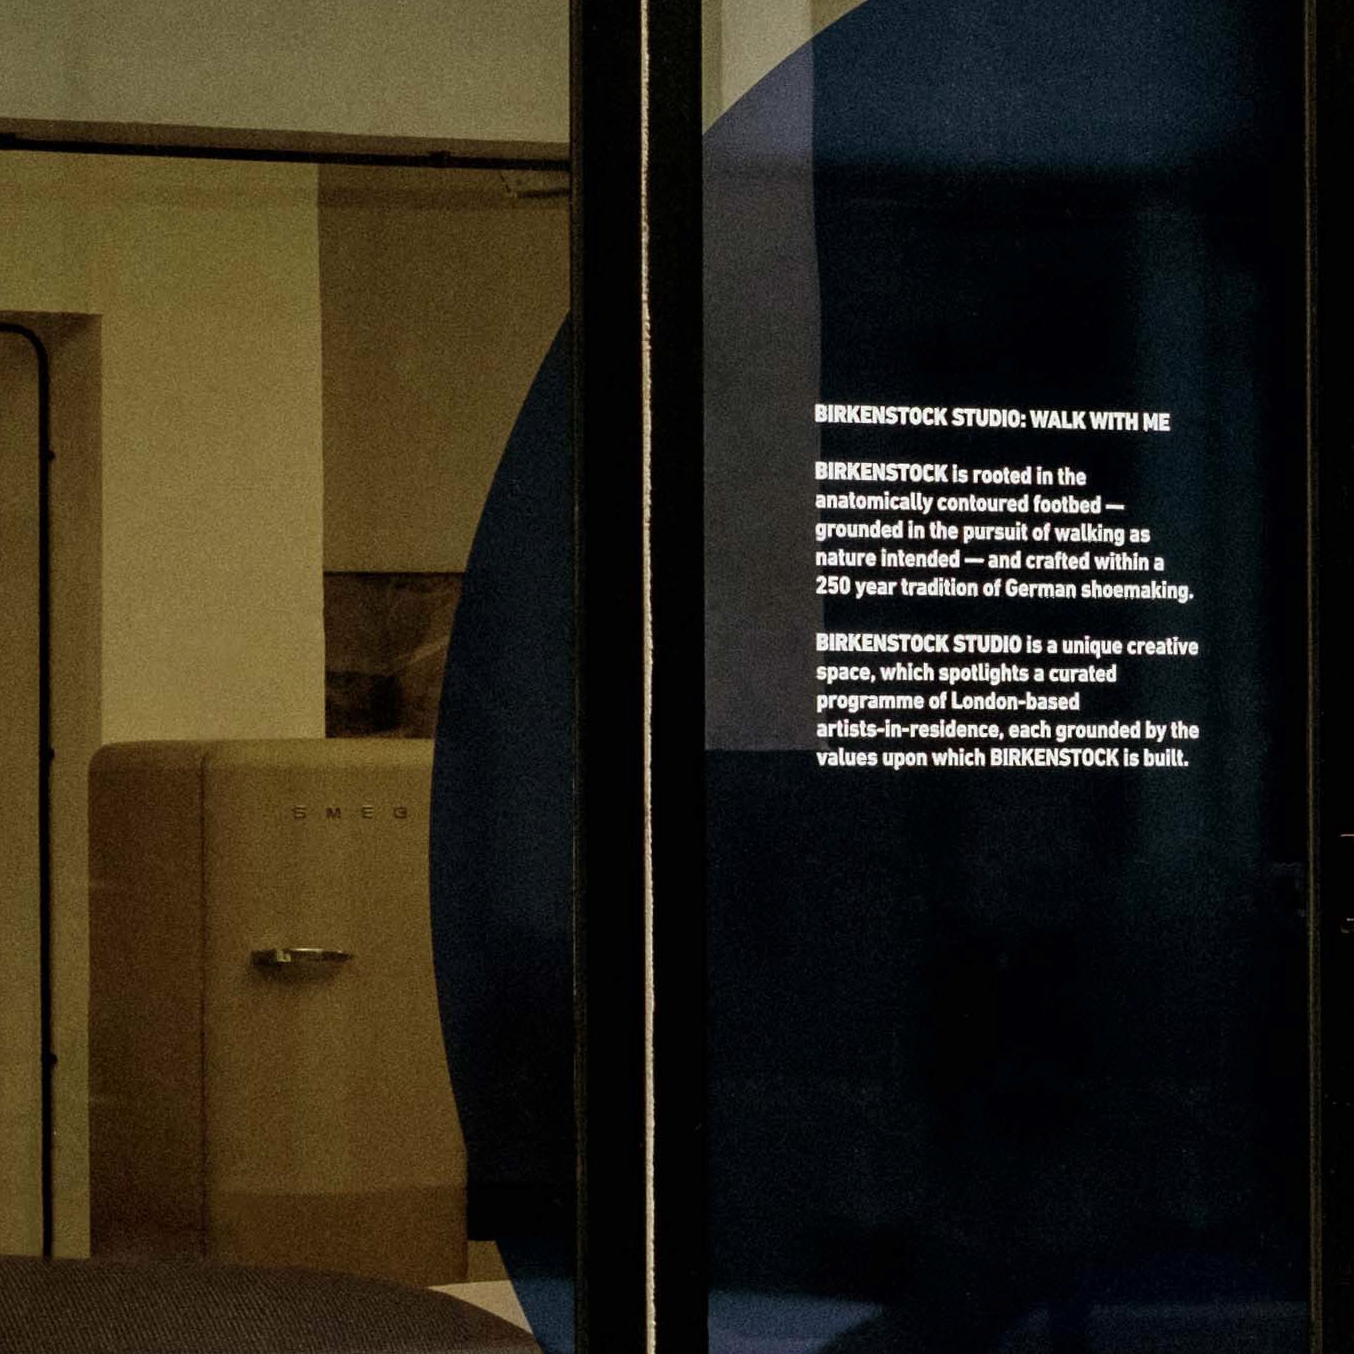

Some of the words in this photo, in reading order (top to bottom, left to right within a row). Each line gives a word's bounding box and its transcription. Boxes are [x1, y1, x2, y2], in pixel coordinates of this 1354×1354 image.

[813, 403, 949, 426] BIRKENSTOCK
[950, 407, 1027, 429] STUDIO:
[1028, 409, 1087, 430] WALK
[1088, 410, 1140, 431] WITH
[1142, 412, 1172, 432] ME
[814, 460, 949, 483] BIRKENSTOCK
[951, 463, 969, 484] is
[972, 465, 1033, 485] rooted
[1035, 465, 1054, 486] in
[1056, 466, 1087, 486] the
[814, 490, 934, 515] anatomically
[936, 493, 1030, 513] contoured
[1032, 494, 1102, 515] footbed
[814, 518, 905, 542] grounded
[907, 519, 926, 540] in
[928, 520, 960, 540] the
[962, 520, 1029, 545] pursuit
[1031, 522, 1052, 542] of
[1053, 522, 1126, 547] walking
[1128, 528, 1152, 544] as
[815, 548, 877, 567] nature
[880, 547, 961, 569] intended
[987, 549, 1022, 570] and
[1025, 550, 1091, 571] crafted
[1093, 551, 1150, 572] within
[1153, 556, 1165, 572] a
[815, 575, 852, 595] 250
[854, 580, 898, 600] year
[900, 576, 979, 598] tradition
[982, 577, 1002, 597] of
[1004, 577, 1077, 599] German
[1080, 579, 1195, 604] shoemaking.
[814, 632, 950, 653] BIRKENSTOCK
[952, 633, 1023, 654] STUDIO
[1025, 634, 1044, 654] is
[1046, 639, 1059, 654] a
[1061, 635, 1124, 660] unique
[1126, 635, 1200, 656] creative
[815, 665, 877, 685] space,
[879, 661, 935, 682] which
[938, 662, 1030, 686] spotlights
[1032, 667, 1045, 682] a
[1048, 663, 1118, 683] curated
[815, 694, 926, 714] programme
[928, 690, 948, 710] of
[950, 690, 1081, 711] London-based
[815, 718, 1005, 741] artists-in-residence,
[1007, 719, 1052, 739] each
[1054, 719, 1142, 743] grounded
[1144, 719, 1168, 743] by
[1169, 720, 1200, 740] the
[815, 746, 879, 767] values
[881, 751, 928, 771] upon
[931, 747, 986, 767] which
[989, 747, 1120, 767] BIRKENSTOCK
[1122, 747, 1140, 767] is
[1143, 747, 1190, 767] built.
[293, 805, 408, 820] SMEG
